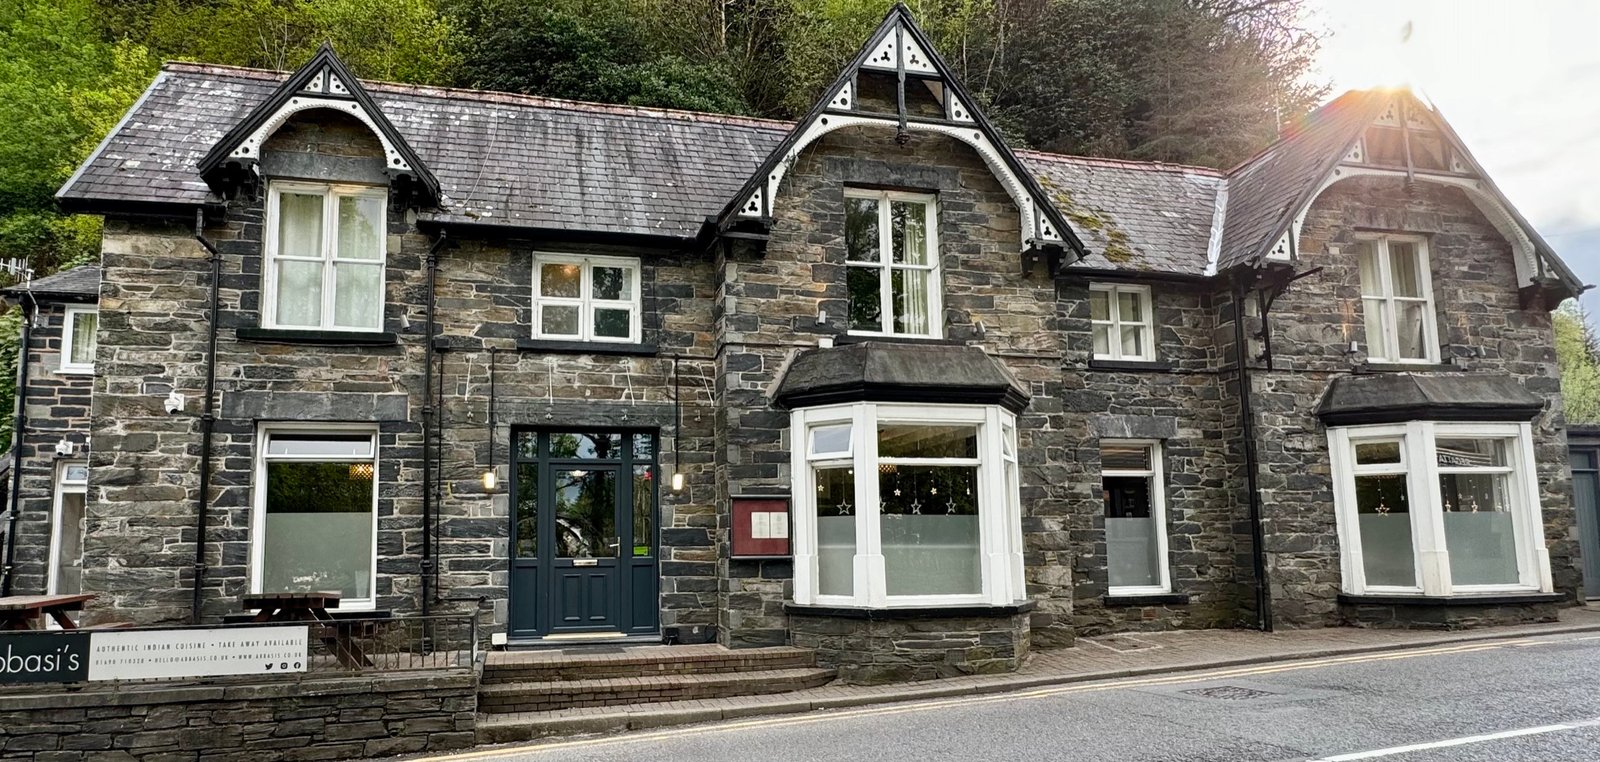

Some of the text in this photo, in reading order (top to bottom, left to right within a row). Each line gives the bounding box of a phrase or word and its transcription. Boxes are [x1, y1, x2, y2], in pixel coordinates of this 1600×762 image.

[97, 639, 302, 653] AUTHENTIC INDIAN CUISINE TAKE AWAY AVAILABLE
